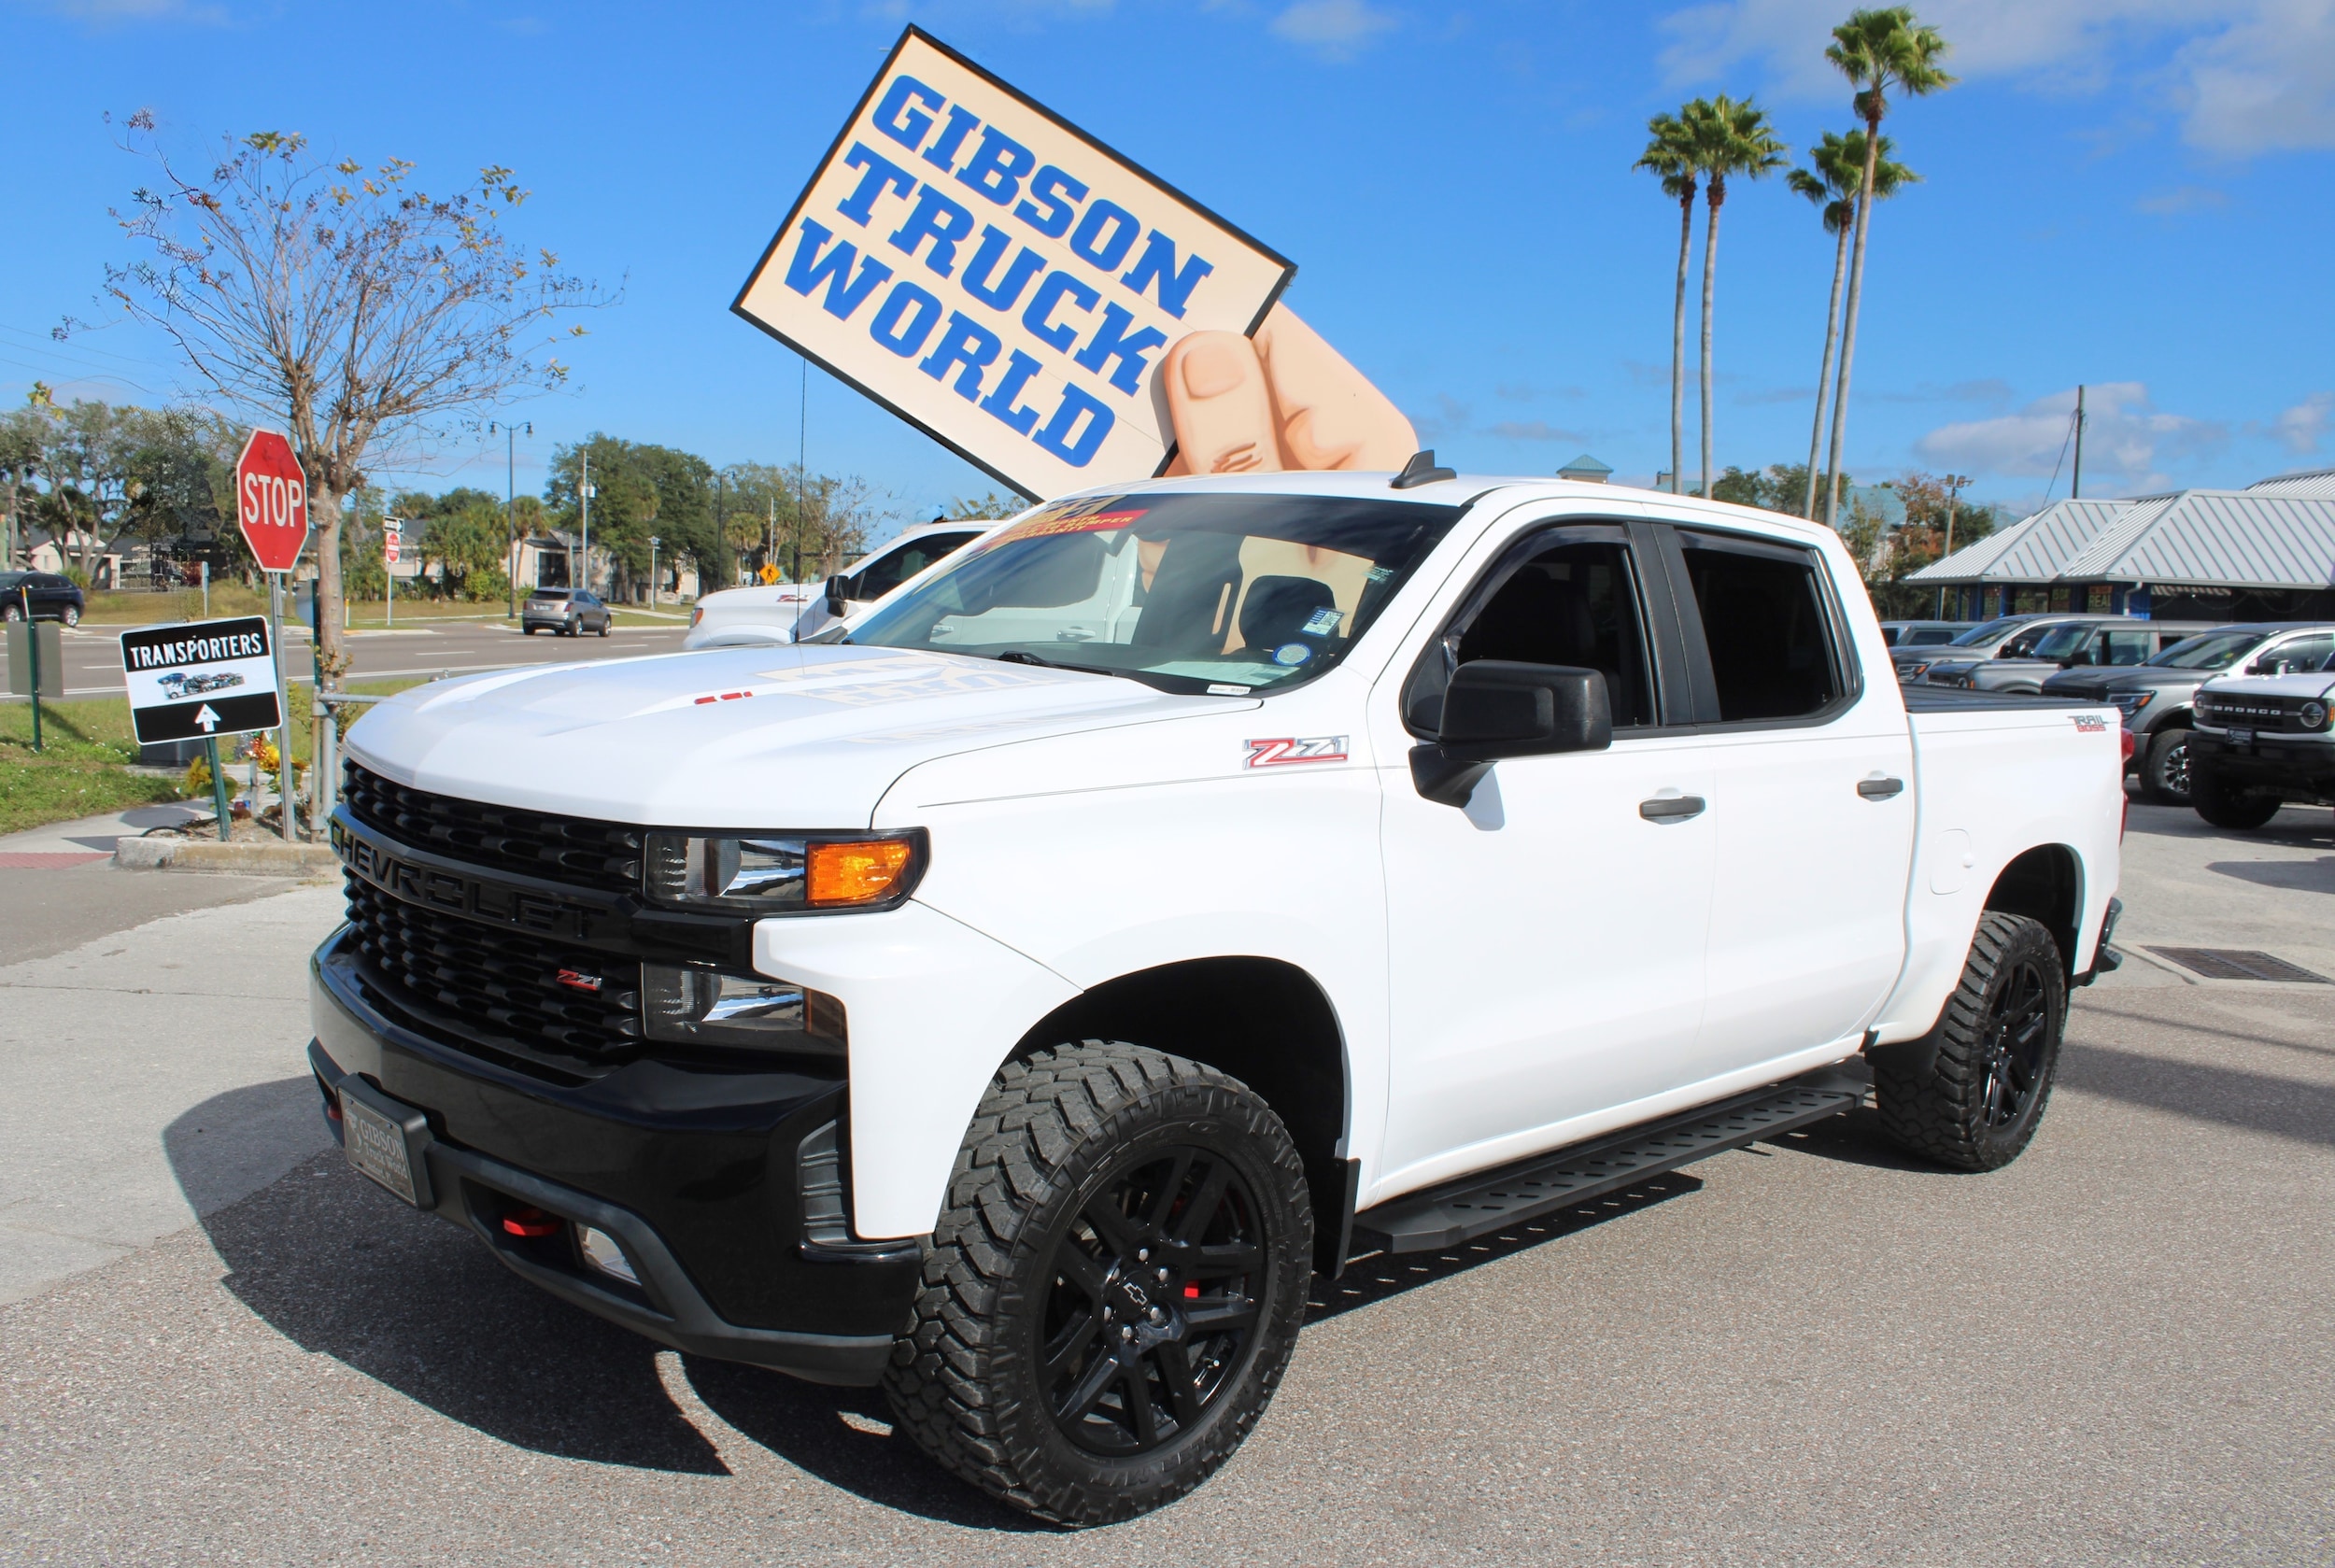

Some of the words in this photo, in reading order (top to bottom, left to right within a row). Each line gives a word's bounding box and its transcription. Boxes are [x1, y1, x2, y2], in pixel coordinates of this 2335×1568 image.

[871, 75, 1214, 319] GIBSON
[836, 141, 1168, 398] TRUCK
[784, 216, 1116, 468] WORLD
[245, 473, 303, 528] STOP
[130, 632, 262, 668] TRANSPORTERS
[2067, 714, 2109, 725] TRAIL
[2076, 724, 2106, 732] BOSS
[2214, 705, 2281, 715] BRONCO
[1242, 735, 1349, 770] Z71
[330, 820, 604, 940] CHEVROLET
[557, 968, 602, 991] Z71
[361, 1120, 405, 1161] GIBSON
